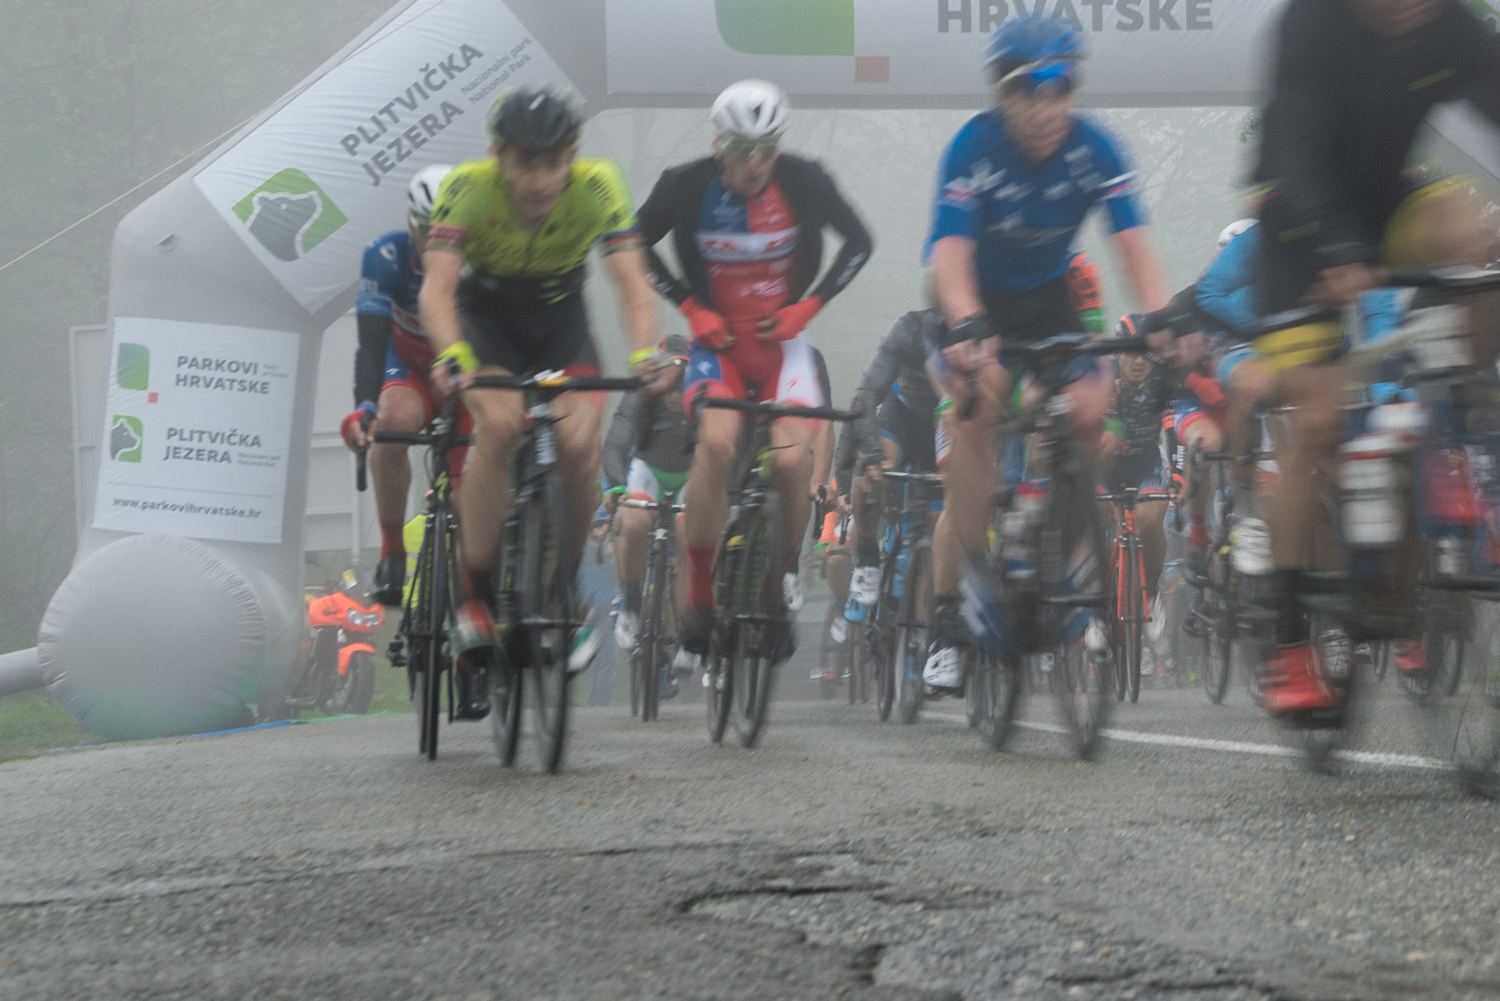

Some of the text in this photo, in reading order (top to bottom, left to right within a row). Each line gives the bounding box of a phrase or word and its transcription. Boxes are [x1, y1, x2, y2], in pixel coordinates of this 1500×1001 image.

[511, 37, 533, 59] park
[508, 54, 531, 74] Park
[339, 43, 485, 158] PLITVIČKA
[361, 100, 465, 188] JEZERA
[177, 355, 259, 376] PARKOVI
[175, 373, 271, 395] HRVATSKE
[167, 427, 262, 449] PLITVIČKA
[164, 446, 232, 464] JEZERA
